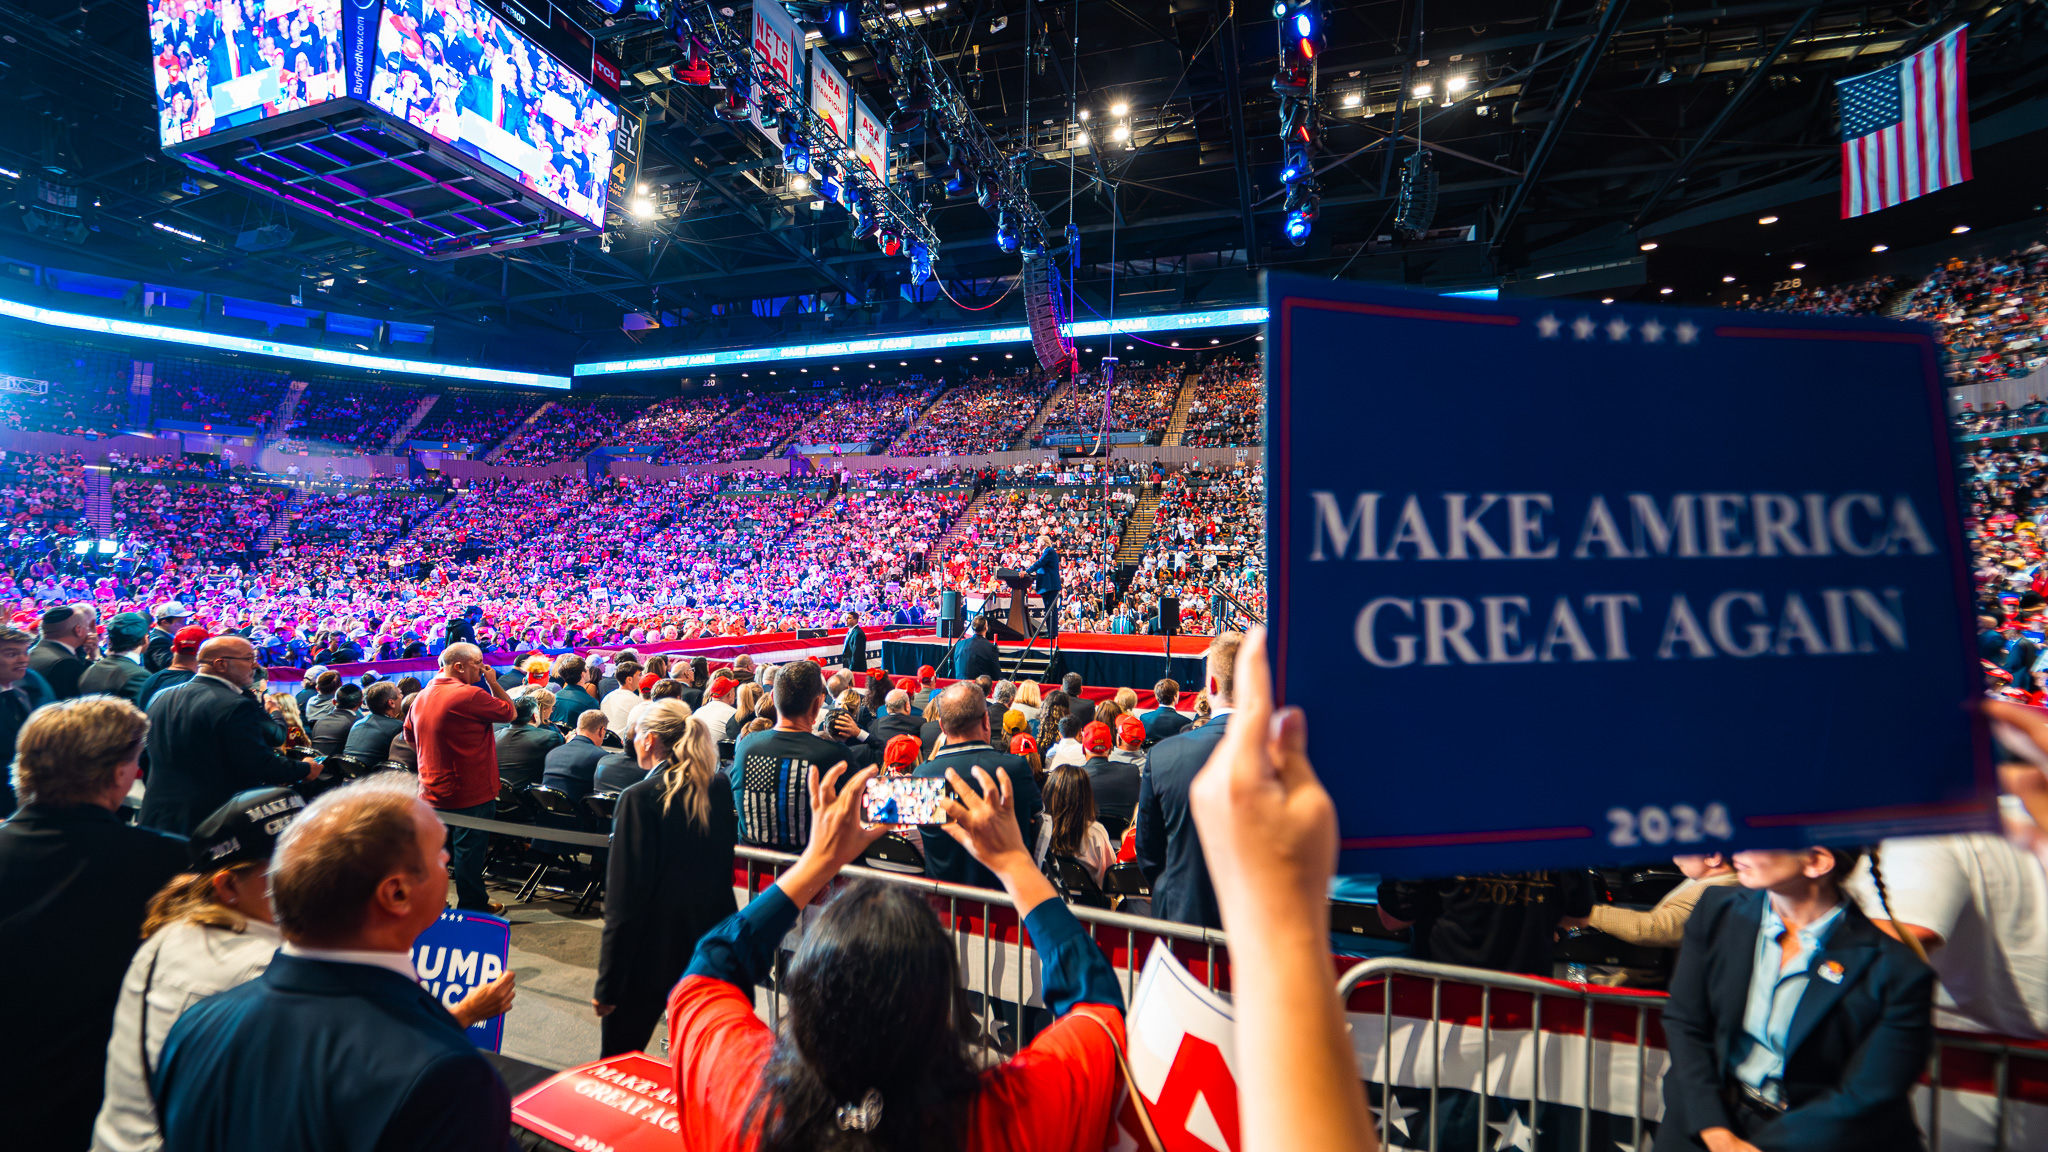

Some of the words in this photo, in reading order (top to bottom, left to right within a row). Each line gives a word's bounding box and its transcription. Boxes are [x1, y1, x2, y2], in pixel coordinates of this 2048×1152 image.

[756, 12, 789, 65] NETS
[354, 16, 365, 94] BuyFordNow.com
[596, 60, 617, 83] TCL
[820, 68, 841, 99] ABA
[813, 79, 844, 118] CHAMPIONS
[617, 115, 639, 138] LY
[617, 129, 636, 156] EL
[862, 117, 880, 144] ABA
[857, 128, 883, 162] CHAMPIONS
[612, 162, 626, 184] 4
[1773, 278, 1802, 291] 228
[702, 379, 716, 387] 220
[1309, 491, 1560, 561] MAKE
[1574, 492, 1939, 559] AMERICA
[1354, 591, 1641, 668] GREAT
[1656, 587, 1908, 661] AGAIN
[1606, 802, 1734, 847] 2024
[408, 945, 502, 986] UMP
[587, 1065, 658, 1095] MAKE
[575, 1079, 649, 1117] GREAT
